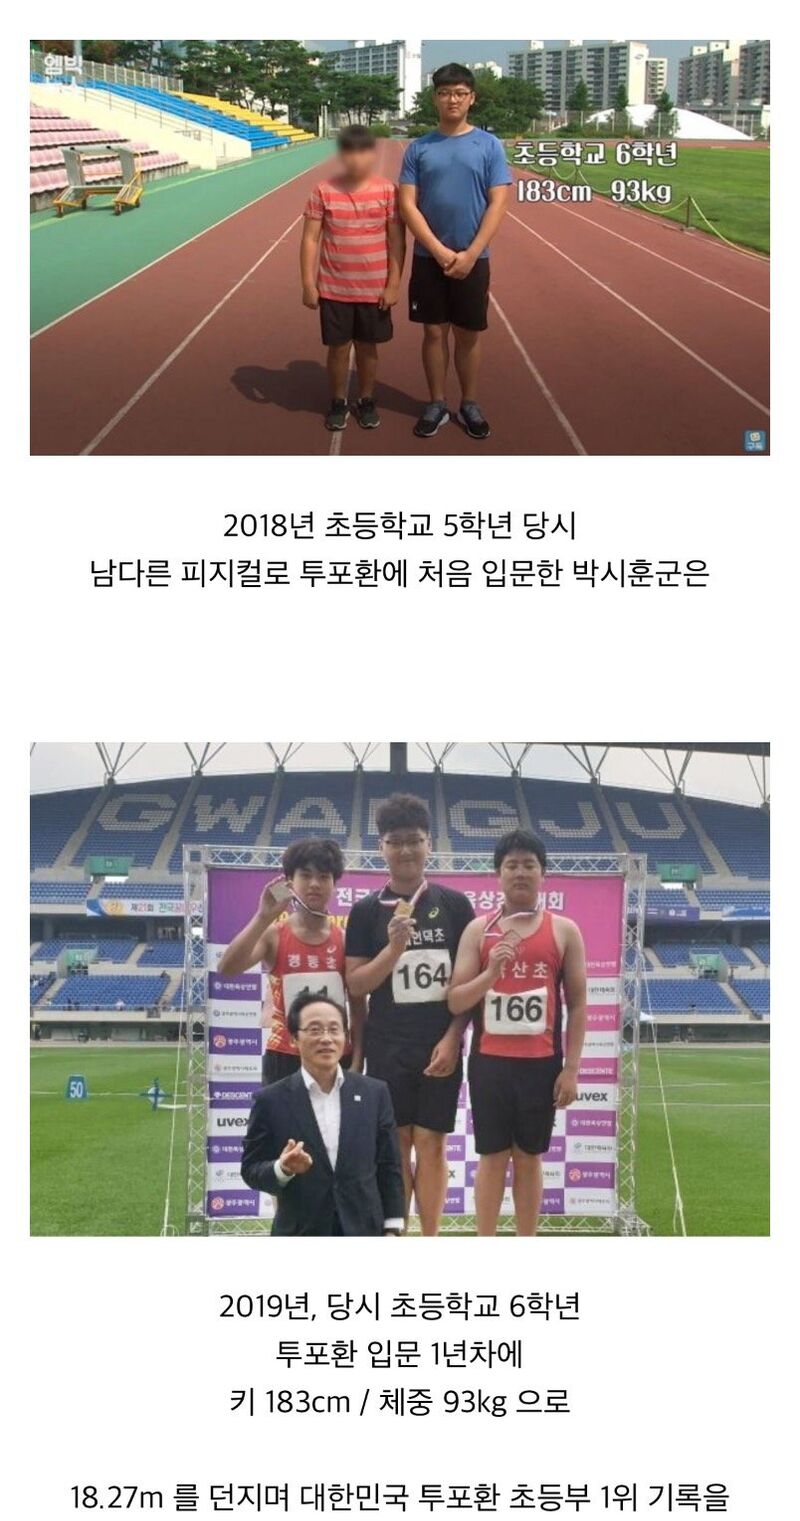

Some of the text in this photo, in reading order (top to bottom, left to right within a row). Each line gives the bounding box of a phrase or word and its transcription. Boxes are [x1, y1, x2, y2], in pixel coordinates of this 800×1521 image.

[397, 963, 448, 990] 164
[490, 995, 543, 1022] 166
[70, 1081, 83, 1098] 50
[575, 1091, 608, 1102] uvex
